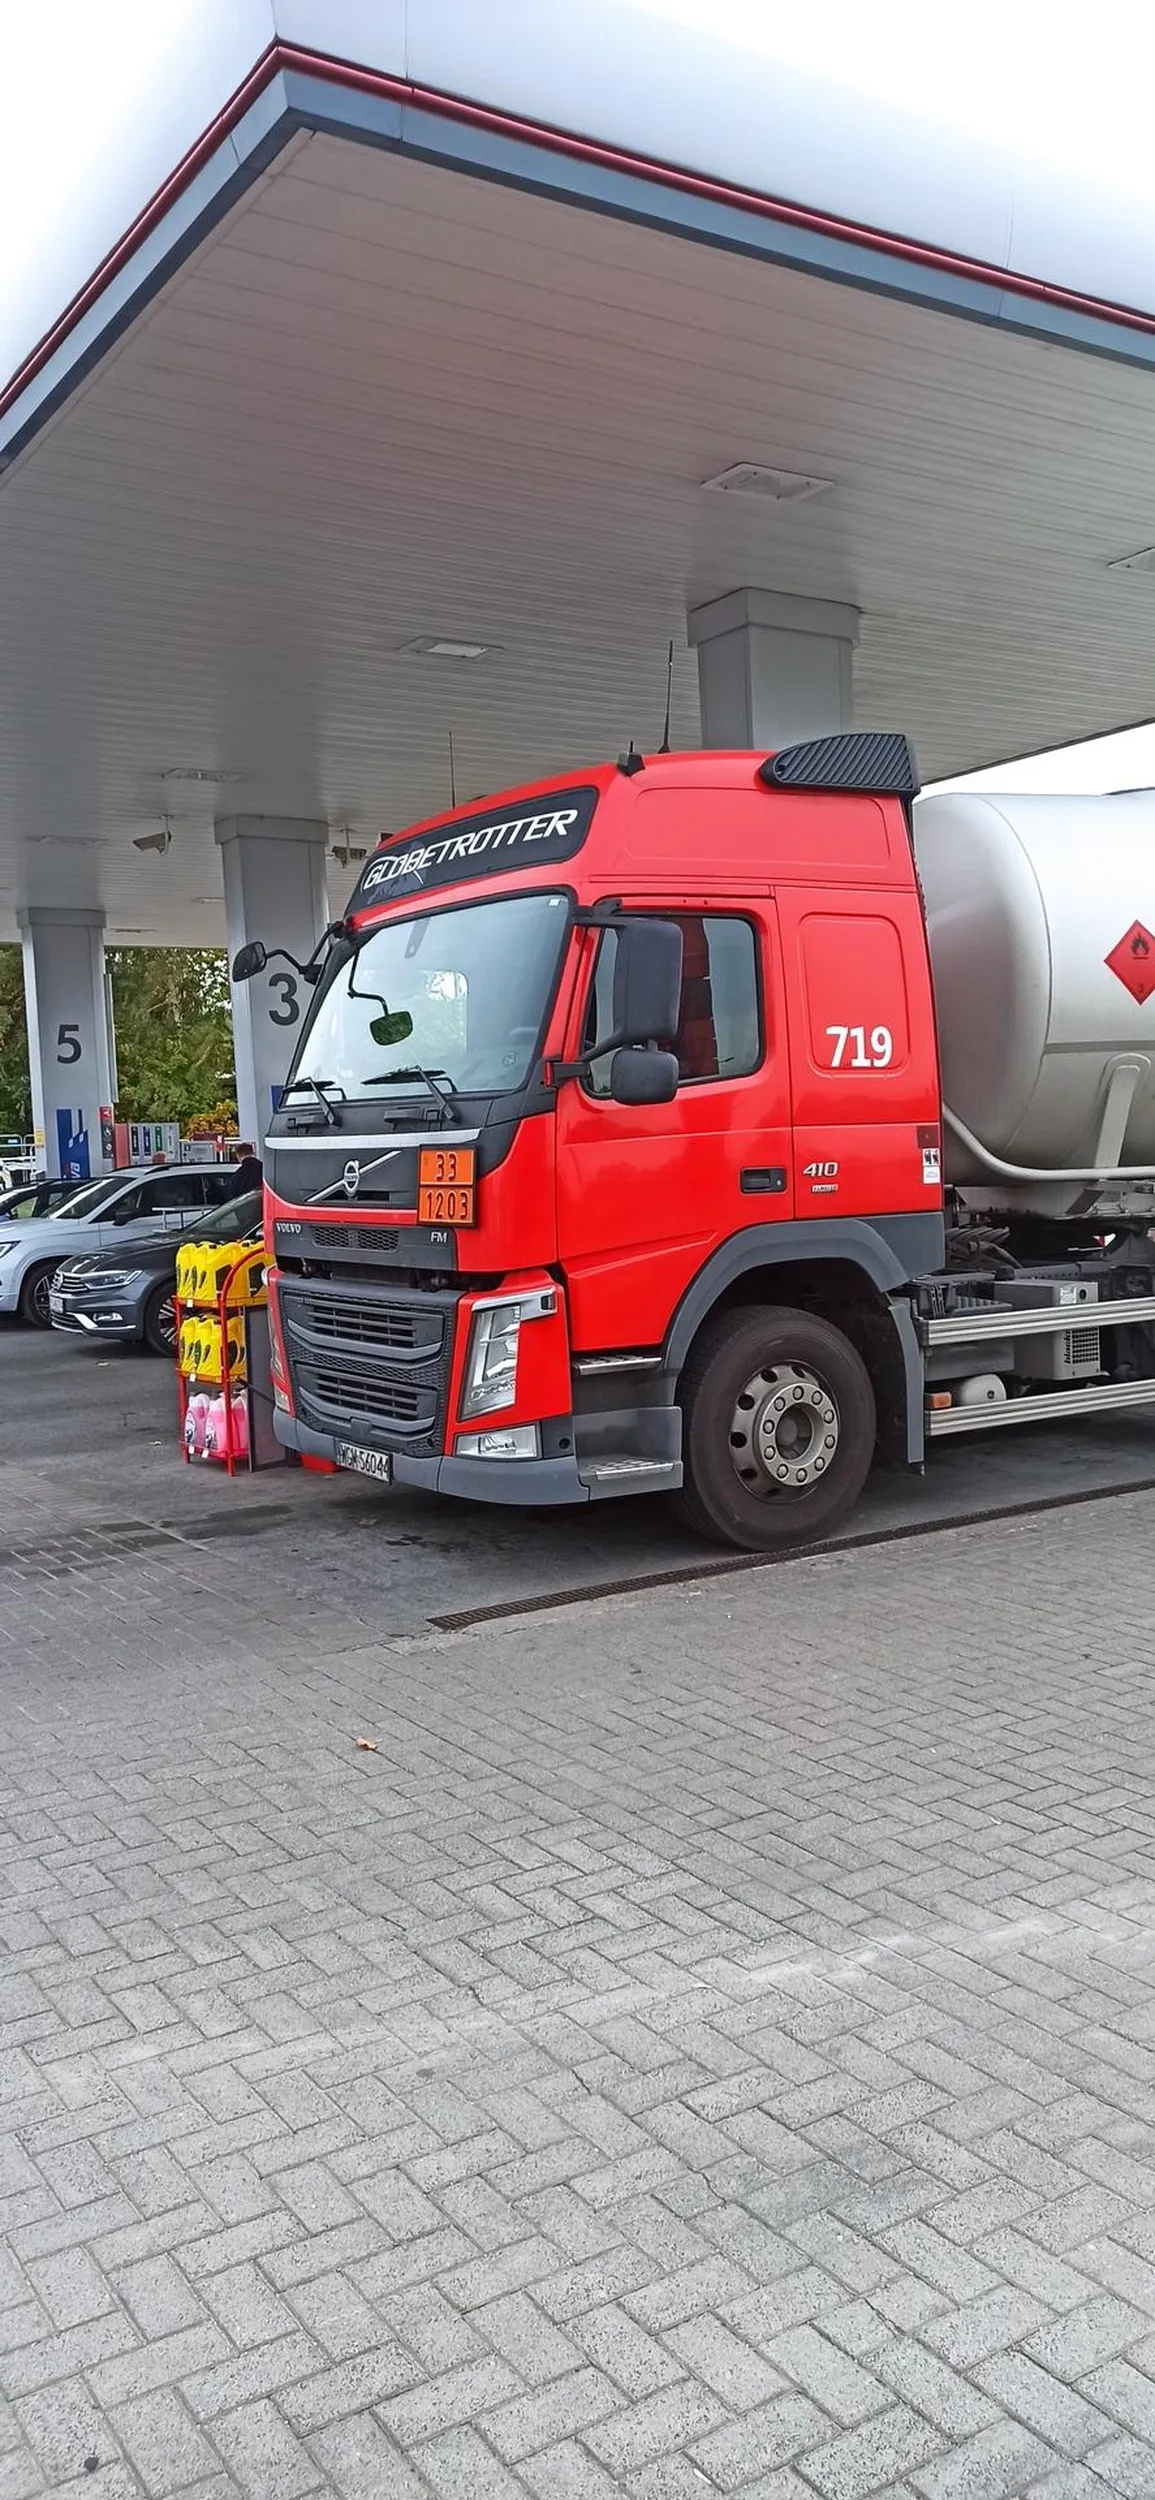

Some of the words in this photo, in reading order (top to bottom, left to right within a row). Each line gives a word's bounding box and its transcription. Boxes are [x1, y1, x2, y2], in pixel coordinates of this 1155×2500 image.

[362, 809, 579, 891] GLOBETROTTER
[269, 972, 300, 1027] 3
[57, 1024, 82, 1064] 5
[826, 1025, 893, 1068] 719
[436, 1152, 457, 1182] 33
[803, 1162, 838, 1177] 410
[426, 1191, 469, 1219] 1203
[430, 1231, 447, 1243] FM
